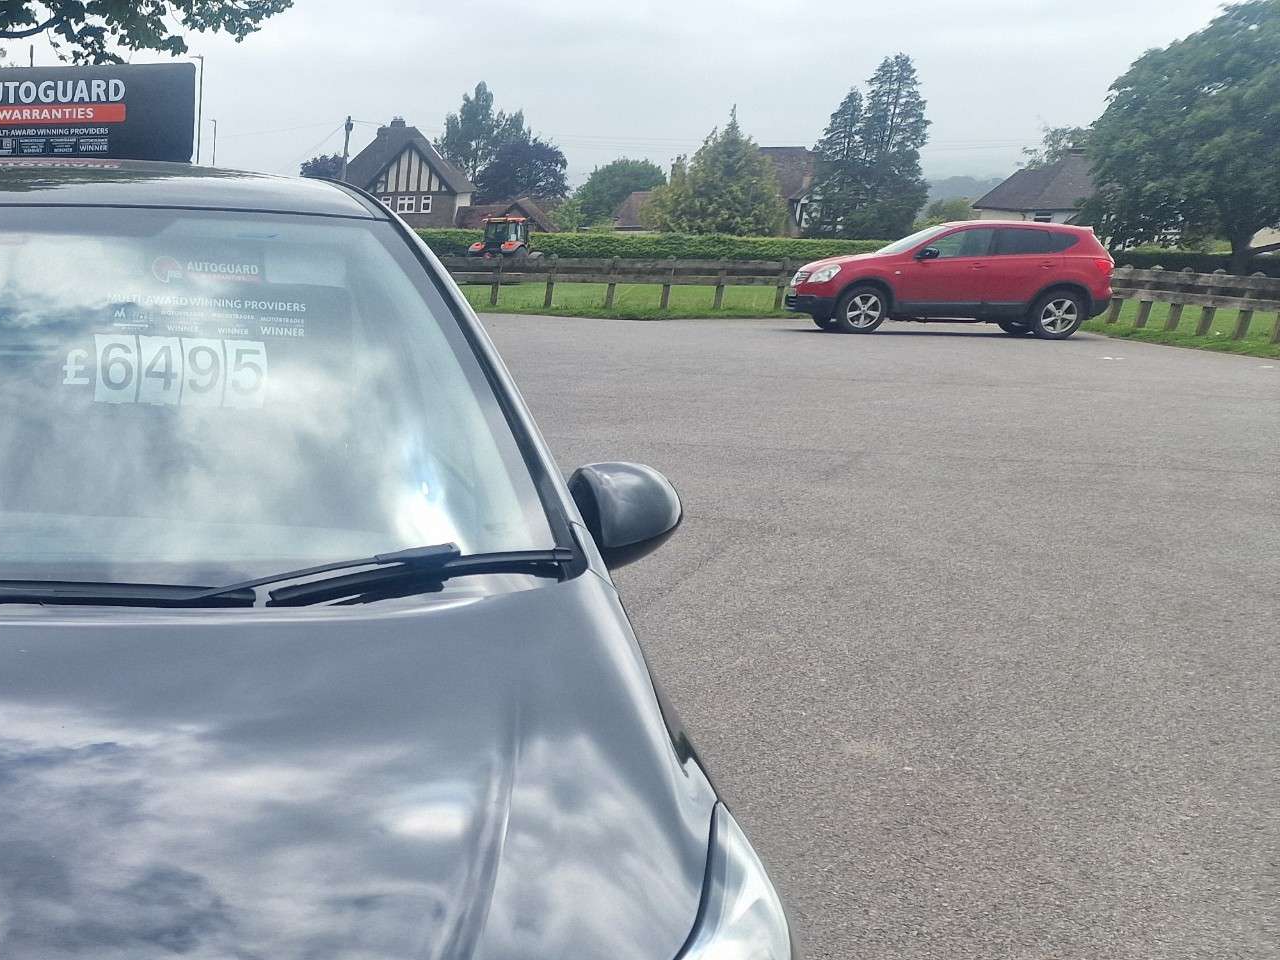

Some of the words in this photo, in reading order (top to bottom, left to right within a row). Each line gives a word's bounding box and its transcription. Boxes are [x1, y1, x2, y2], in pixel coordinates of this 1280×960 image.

[70, 127, 109, 135] PROVIDERS
[187, 261, 258, 275] AUTOGUARD
[190, 297, 242, 309] WINNING
[244, 300, 307, 312] PROVIDERS
[260, 325, 305, 337] WINNER
